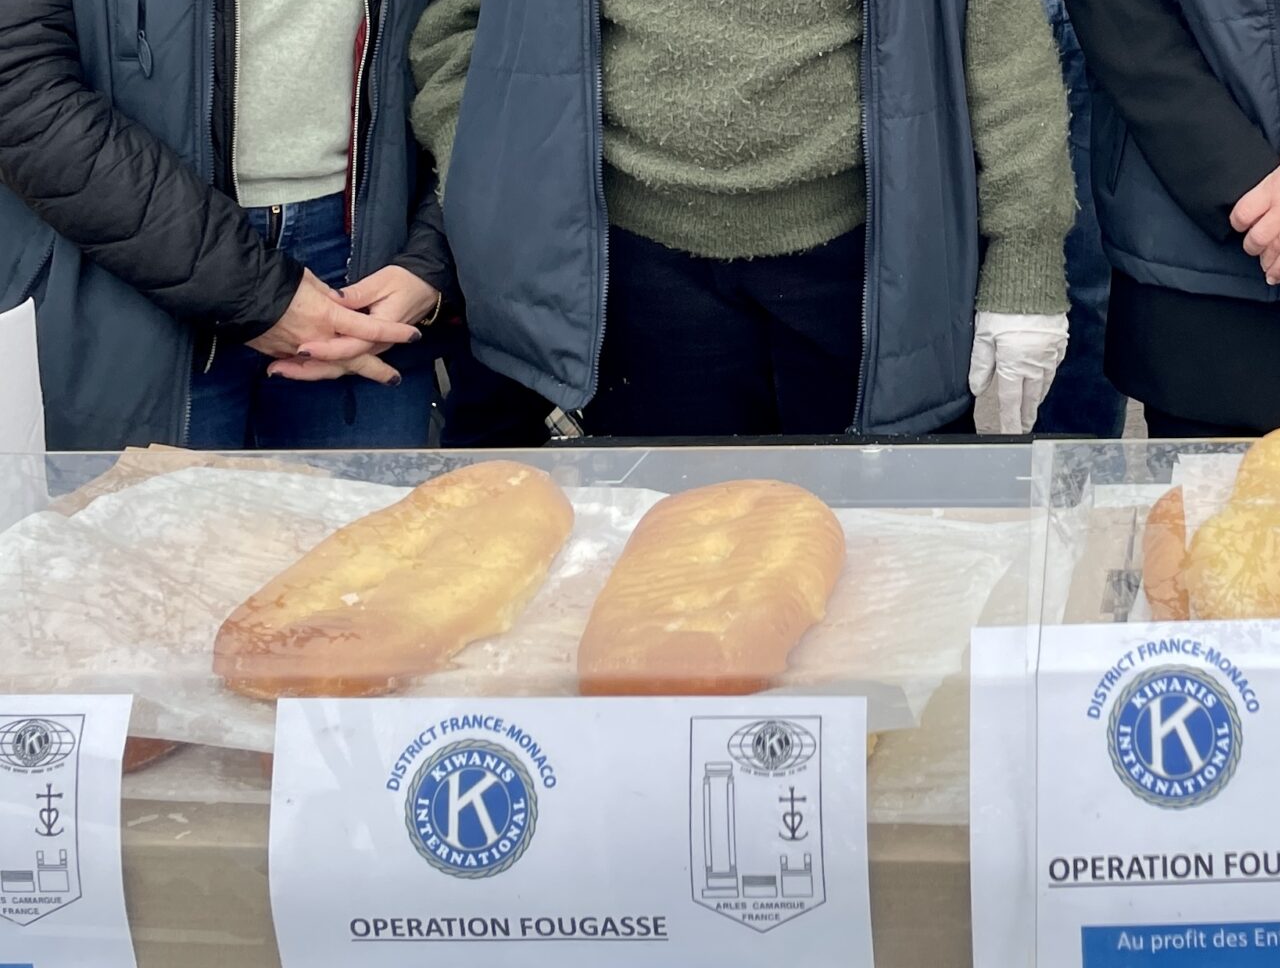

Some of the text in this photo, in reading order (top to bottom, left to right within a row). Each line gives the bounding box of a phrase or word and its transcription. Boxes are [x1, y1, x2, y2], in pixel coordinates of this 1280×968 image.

[1087, 638, 1260, 720] DISTRICT FRANCE-MONACO
[1130, 678, 1217, 710] KIWANIS
[1149, 695, 1205, 778] K
[386, 714, 557, 792] DISTRICT FRANCE-MONACO
[430, 751, 516, 783] KIWANIS
[1118, 722, 1230, 796] INTERNATIONAL
[446, 768, 500, 851] K
[416, 796, 525, 867] INTERNATIONAL
[1048, 852, 1214, 882] OPERATION
[2, 907, 40, 916] FRANCE
[11, 895, 62, 905] CAMARGUE
[715, 901, 806, 911] ARLES CAMARGUE
[349, 916, 668, 937] OPERATION FOUGASSE
[742, 913, 781, 922] FRANCE
[1116, 931, 1144, 951] Au
[1151, 929, 1207, 955] profit
[1212, 929, 1248, 949] des
